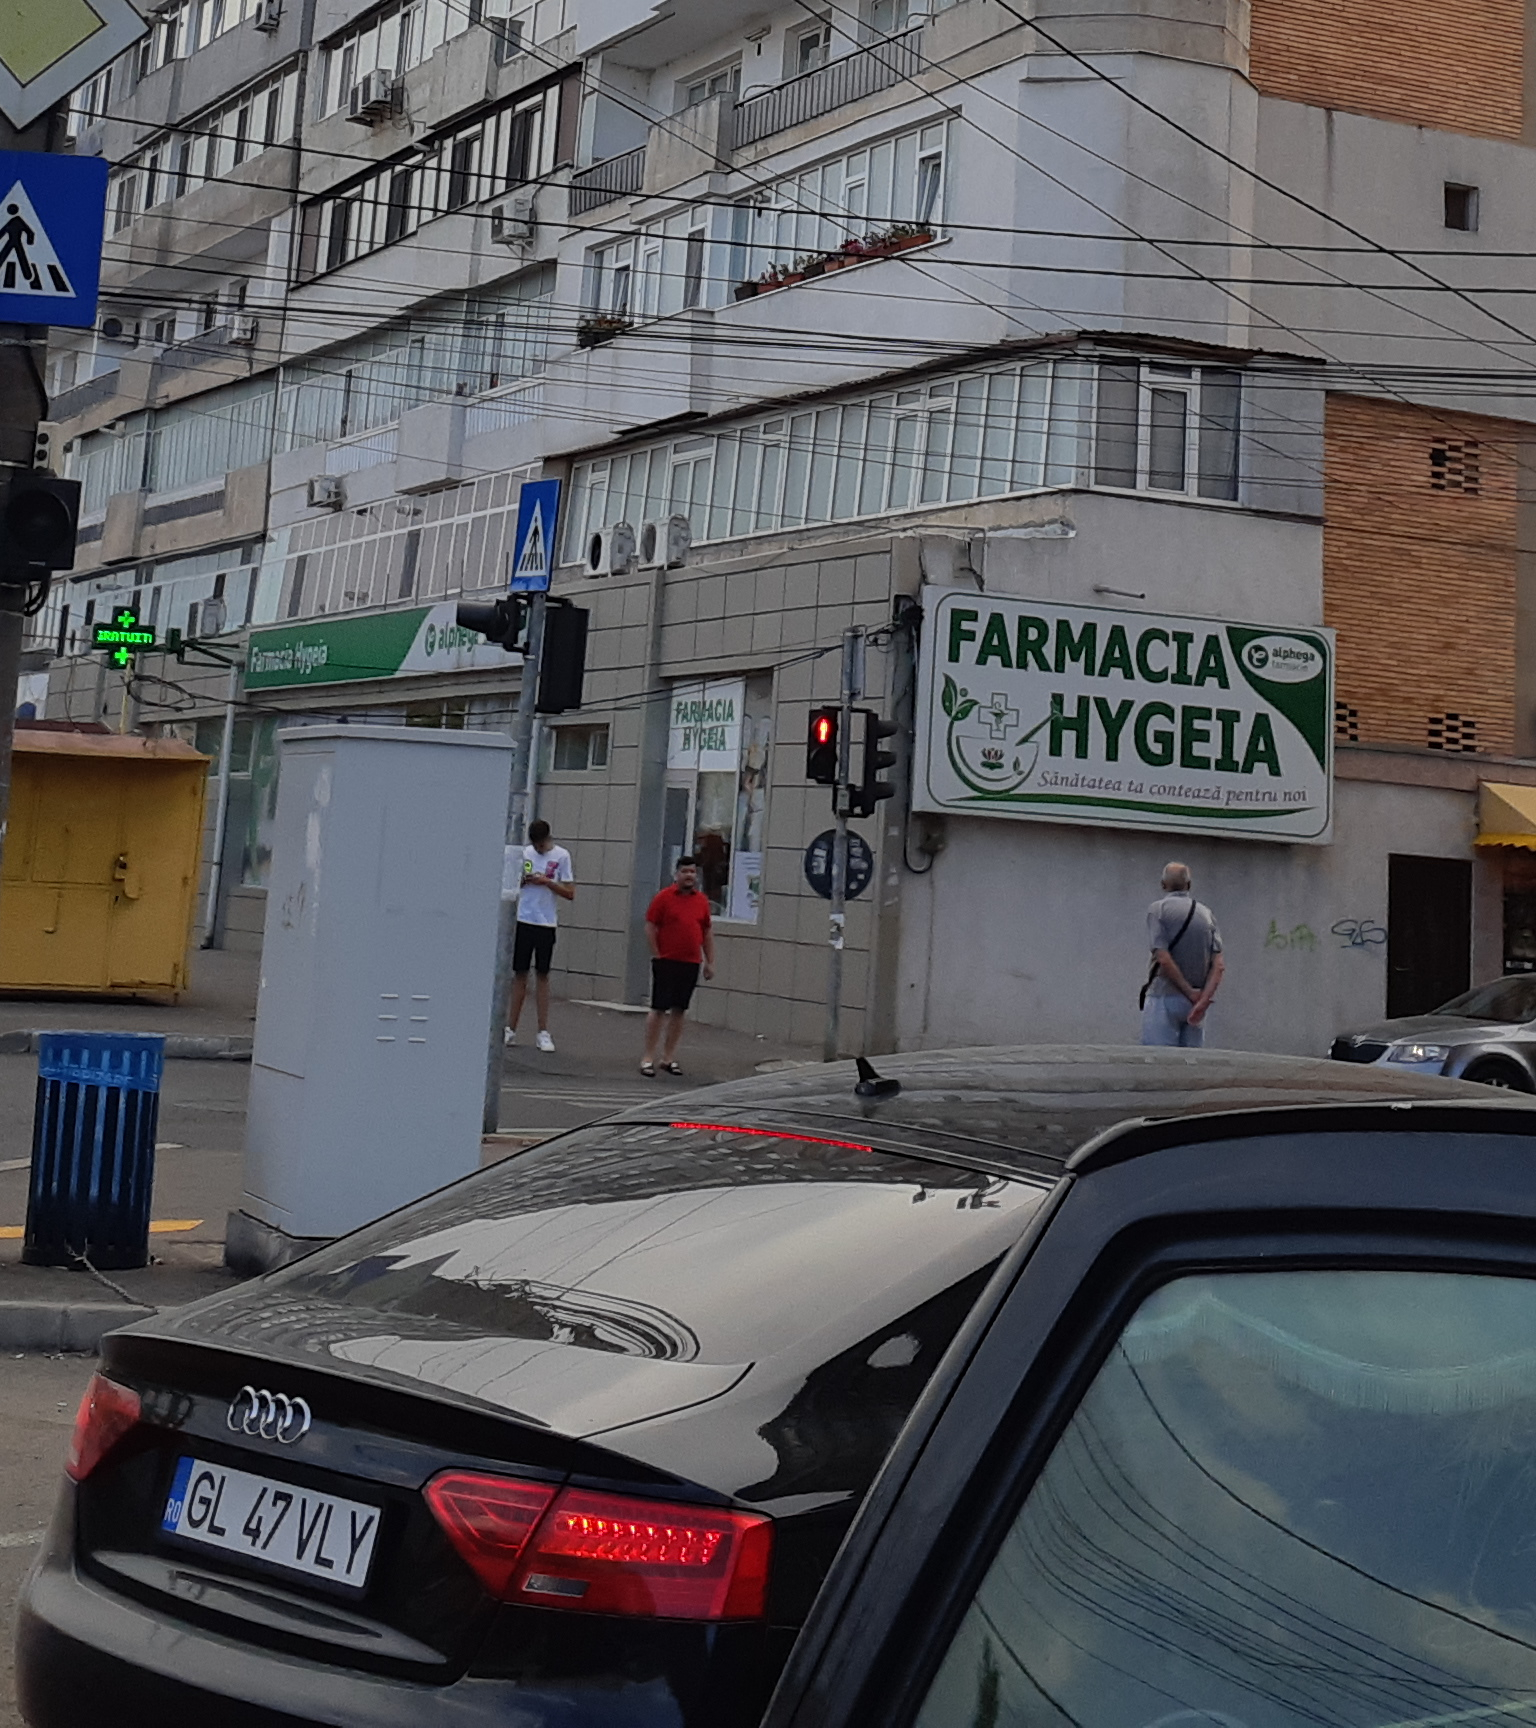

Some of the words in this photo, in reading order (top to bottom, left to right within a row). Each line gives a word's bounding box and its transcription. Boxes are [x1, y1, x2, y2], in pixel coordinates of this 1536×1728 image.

[250, 642, 294, 673] Farmacia
[293, 638, 328, 675] Hygeia
[947, 607, 1231, 690] FARMACIA
[1272, 646, 1315, 663] alphega
[674, 698, 736, 725] FARMACIA
[681, 726, 728, 752] HYGEIA
[1048, 692, 1283, 778] HYGEIA
[1127, 778, 1145, 794] ta
[1224, 788, 1279, 806] pentru
[1282, 785, 1307, 802] noi
[164, 1497, 183, 1522] RO
[186, 1470, 227, 1537] GL
[242, 1486, 294, 1551] 47
[295, 1497, 376, 1575] VLY
